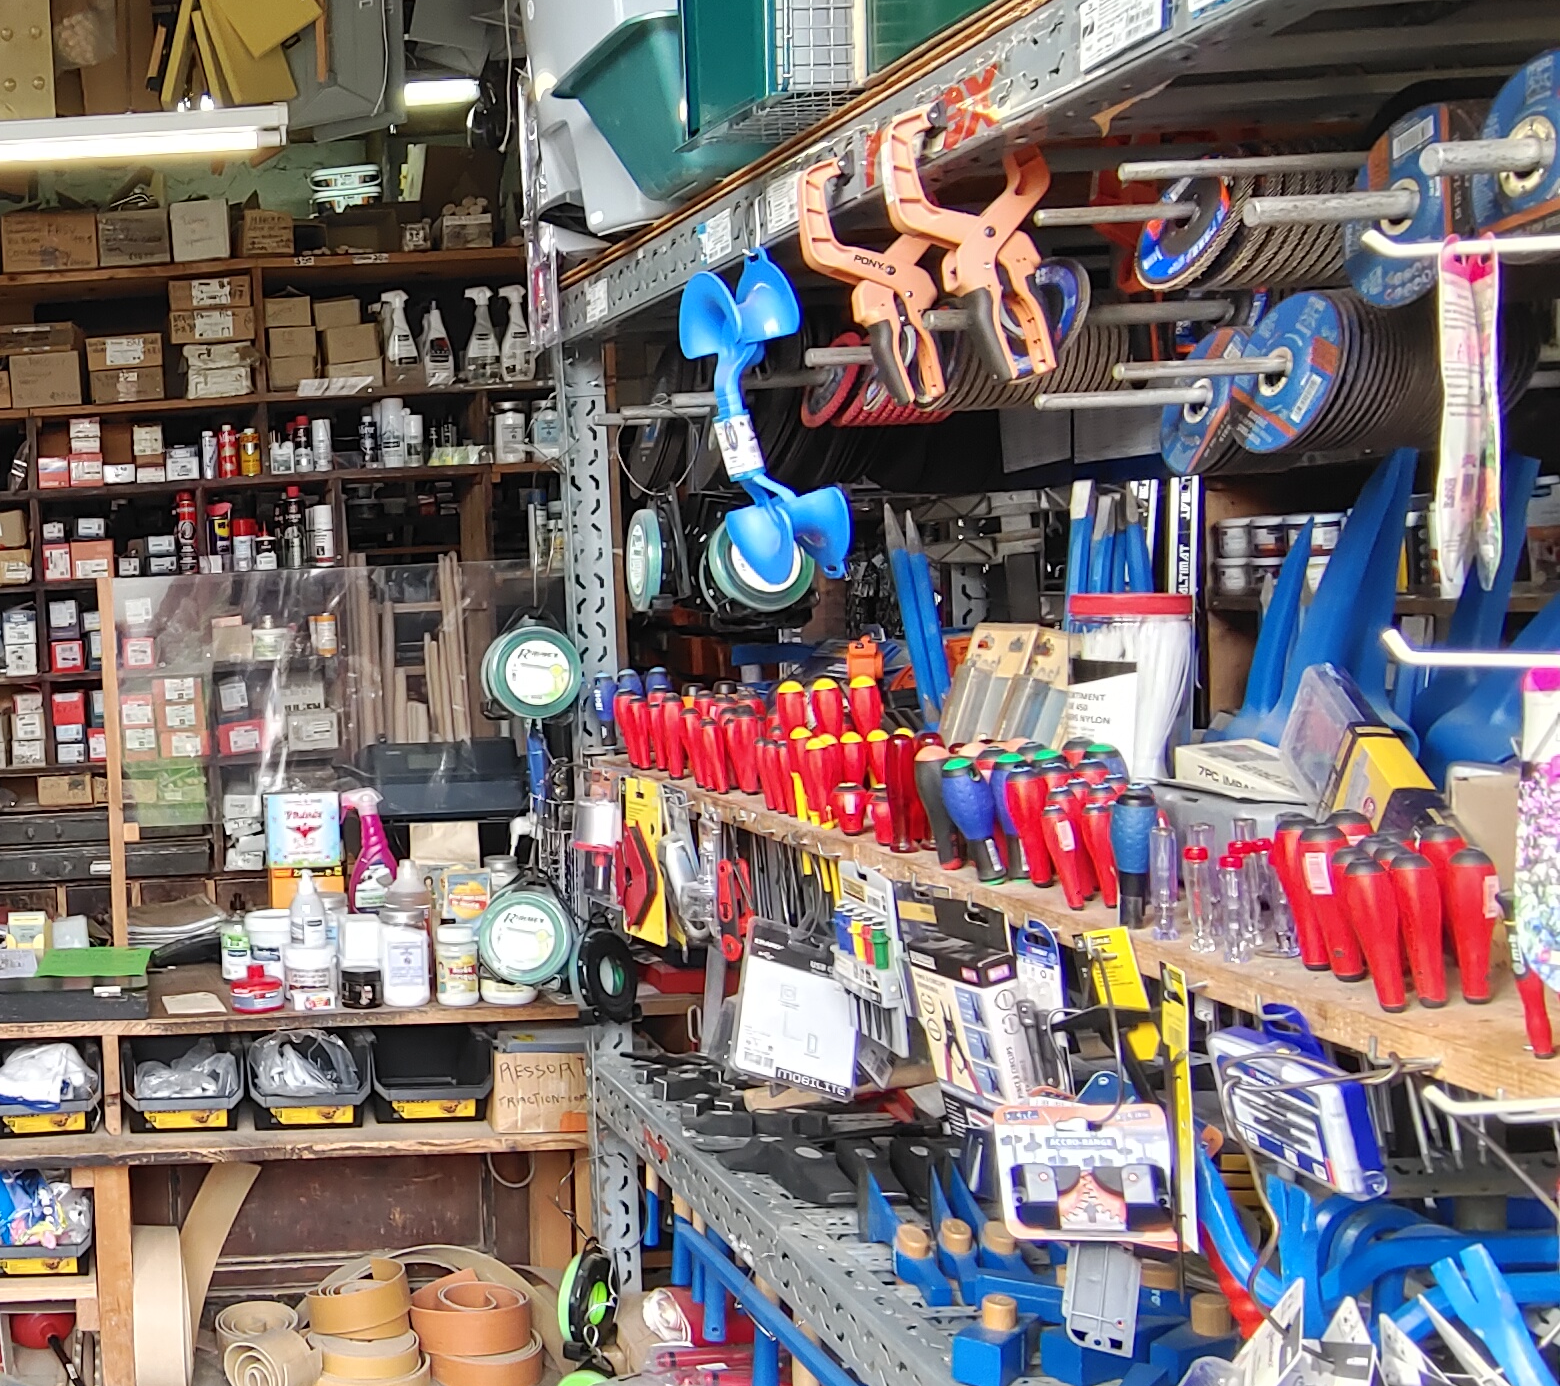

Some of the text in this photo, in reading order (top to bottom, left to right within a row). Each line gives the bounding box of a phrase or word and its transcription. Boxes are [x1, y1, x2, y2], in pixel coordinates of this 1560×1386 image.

[854, 254, 885, 269] PONY
[1080, 714, 1111, 725] NYLON
[777, 1068, 847, 1098] MOBILITE
[499, 1092, 588, 1112] TRACTION-COM
